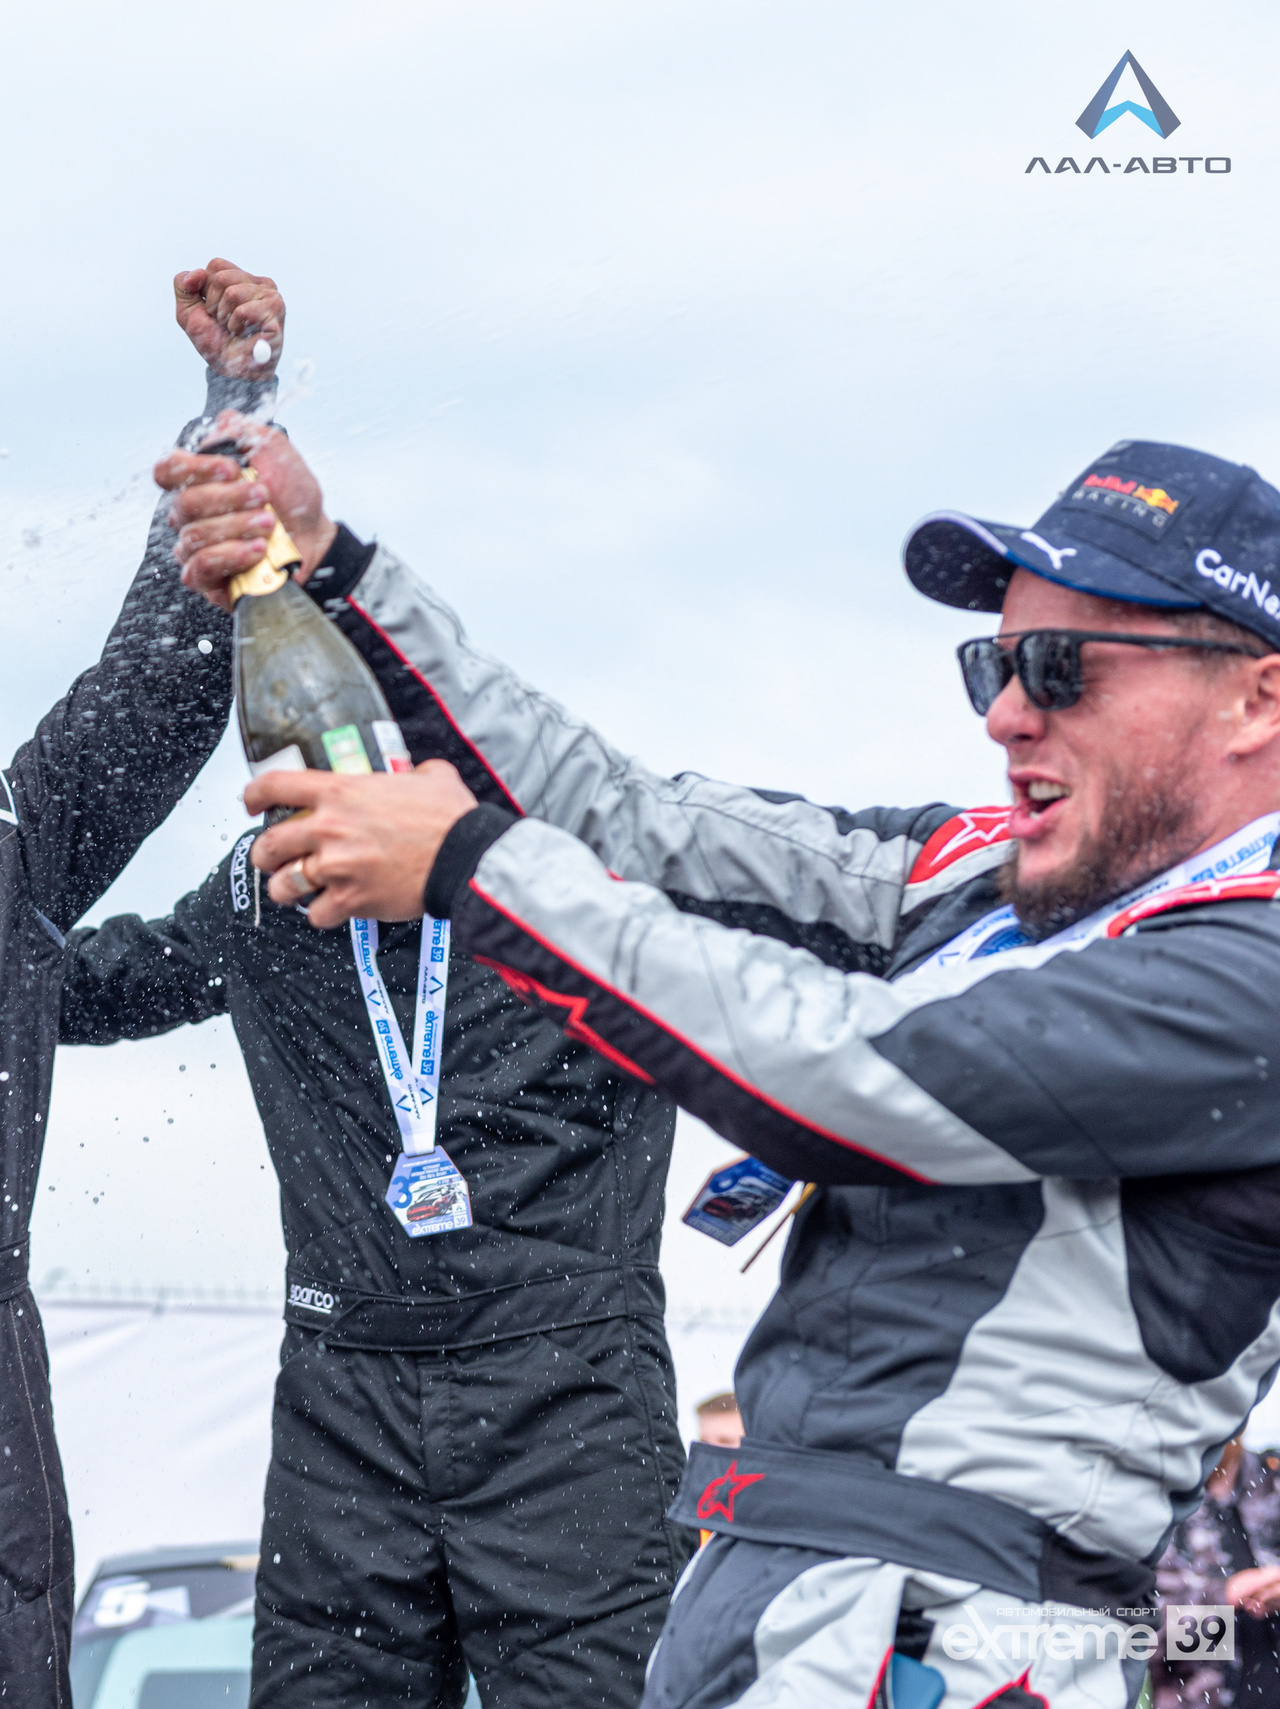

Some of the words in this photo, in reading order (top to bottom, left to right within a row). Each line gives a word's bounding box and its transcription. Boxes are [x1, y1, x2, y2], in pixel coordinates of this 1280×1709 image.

[1195, 548, 1280, 619] CarNe
[235, 834, 255, 910] sparco
[432, 948, 443, 961] 39
[377, 1021, 389, 1034] 39
[422, 1010, 438, 1058] extreme
[384, 1035, 404, 1081] extreme
[421, 1061, 433, 1074] 39
[392, 1175, 412, 1209] 3
[290, 1284, 334, 1309] sparco
